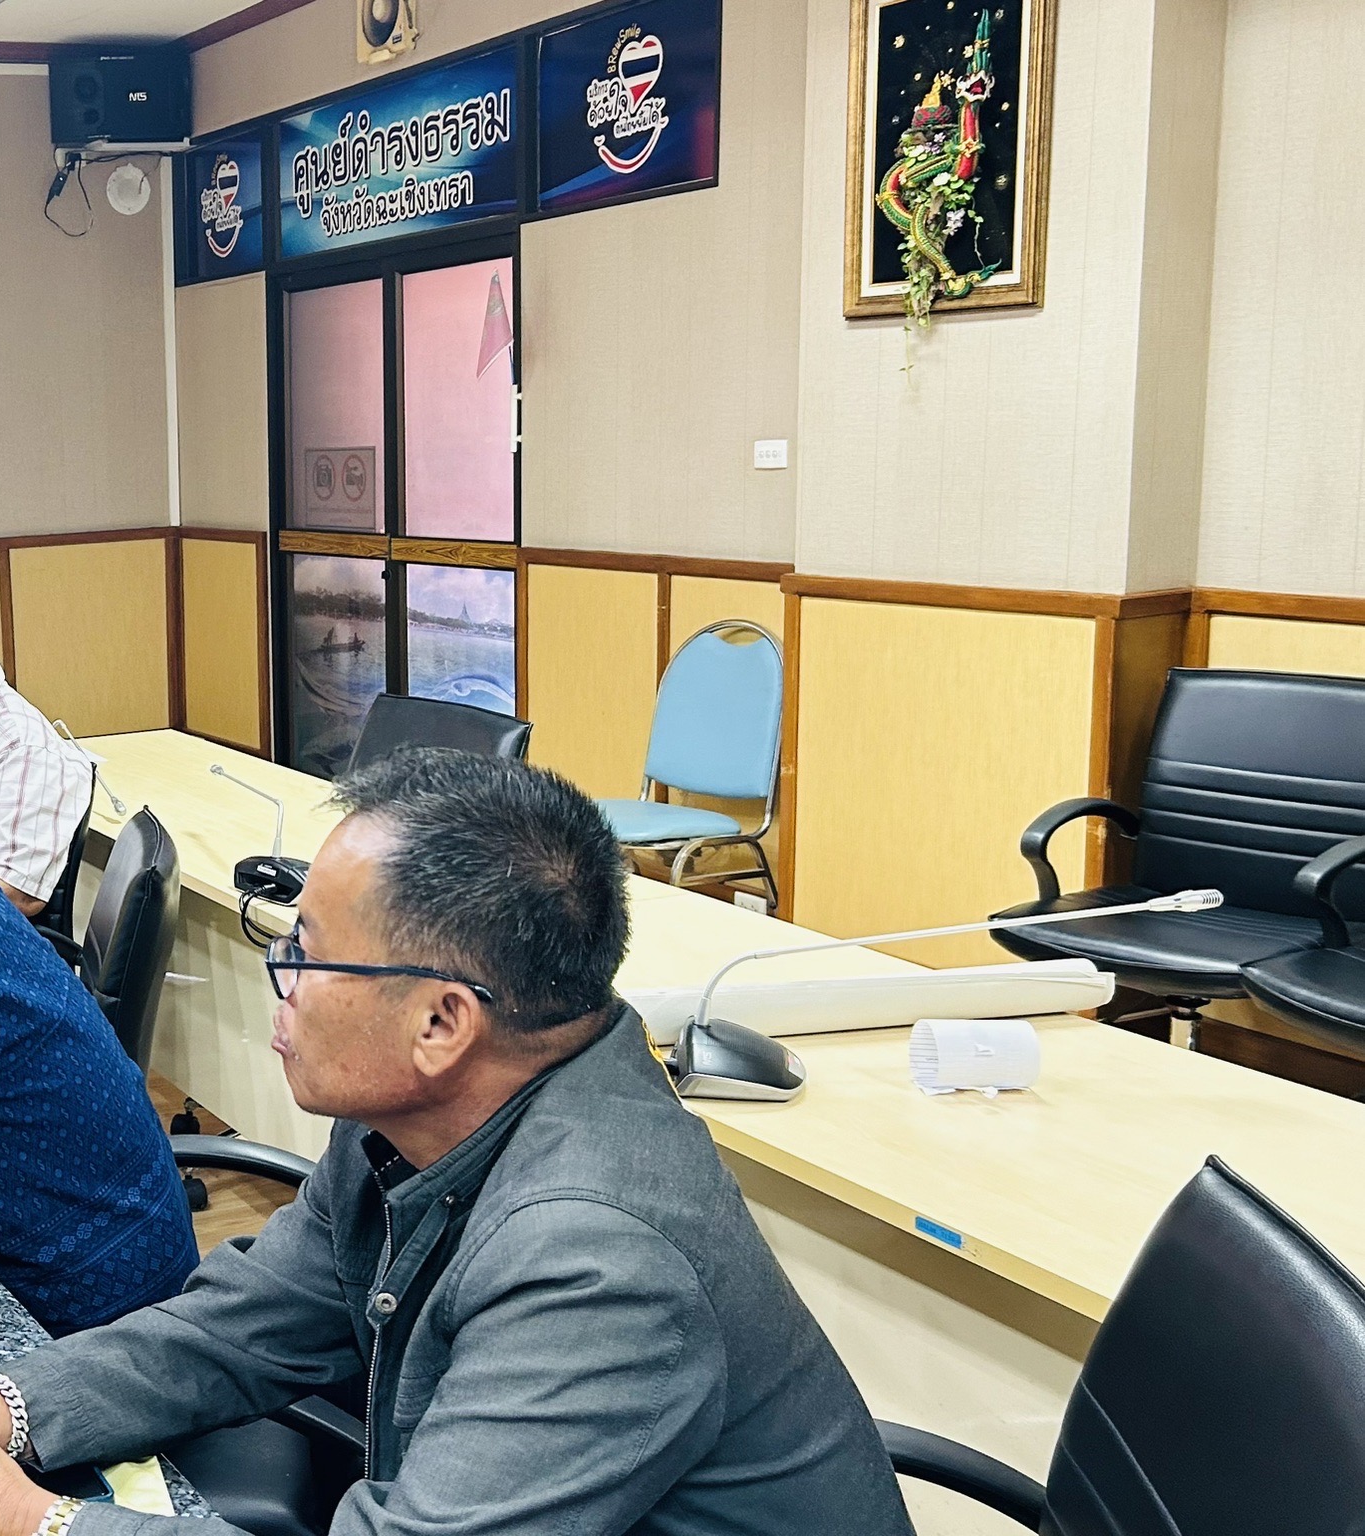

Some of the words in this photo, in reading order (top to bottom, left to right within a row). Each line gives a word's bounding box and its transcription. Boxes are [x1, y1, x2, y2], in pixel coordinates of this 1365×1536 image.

[293, 88, 510, 219] ศูนย์ดำรงธรรม
[320, 171, 474, 237] จังหวัดฉะเชิงเทรา
